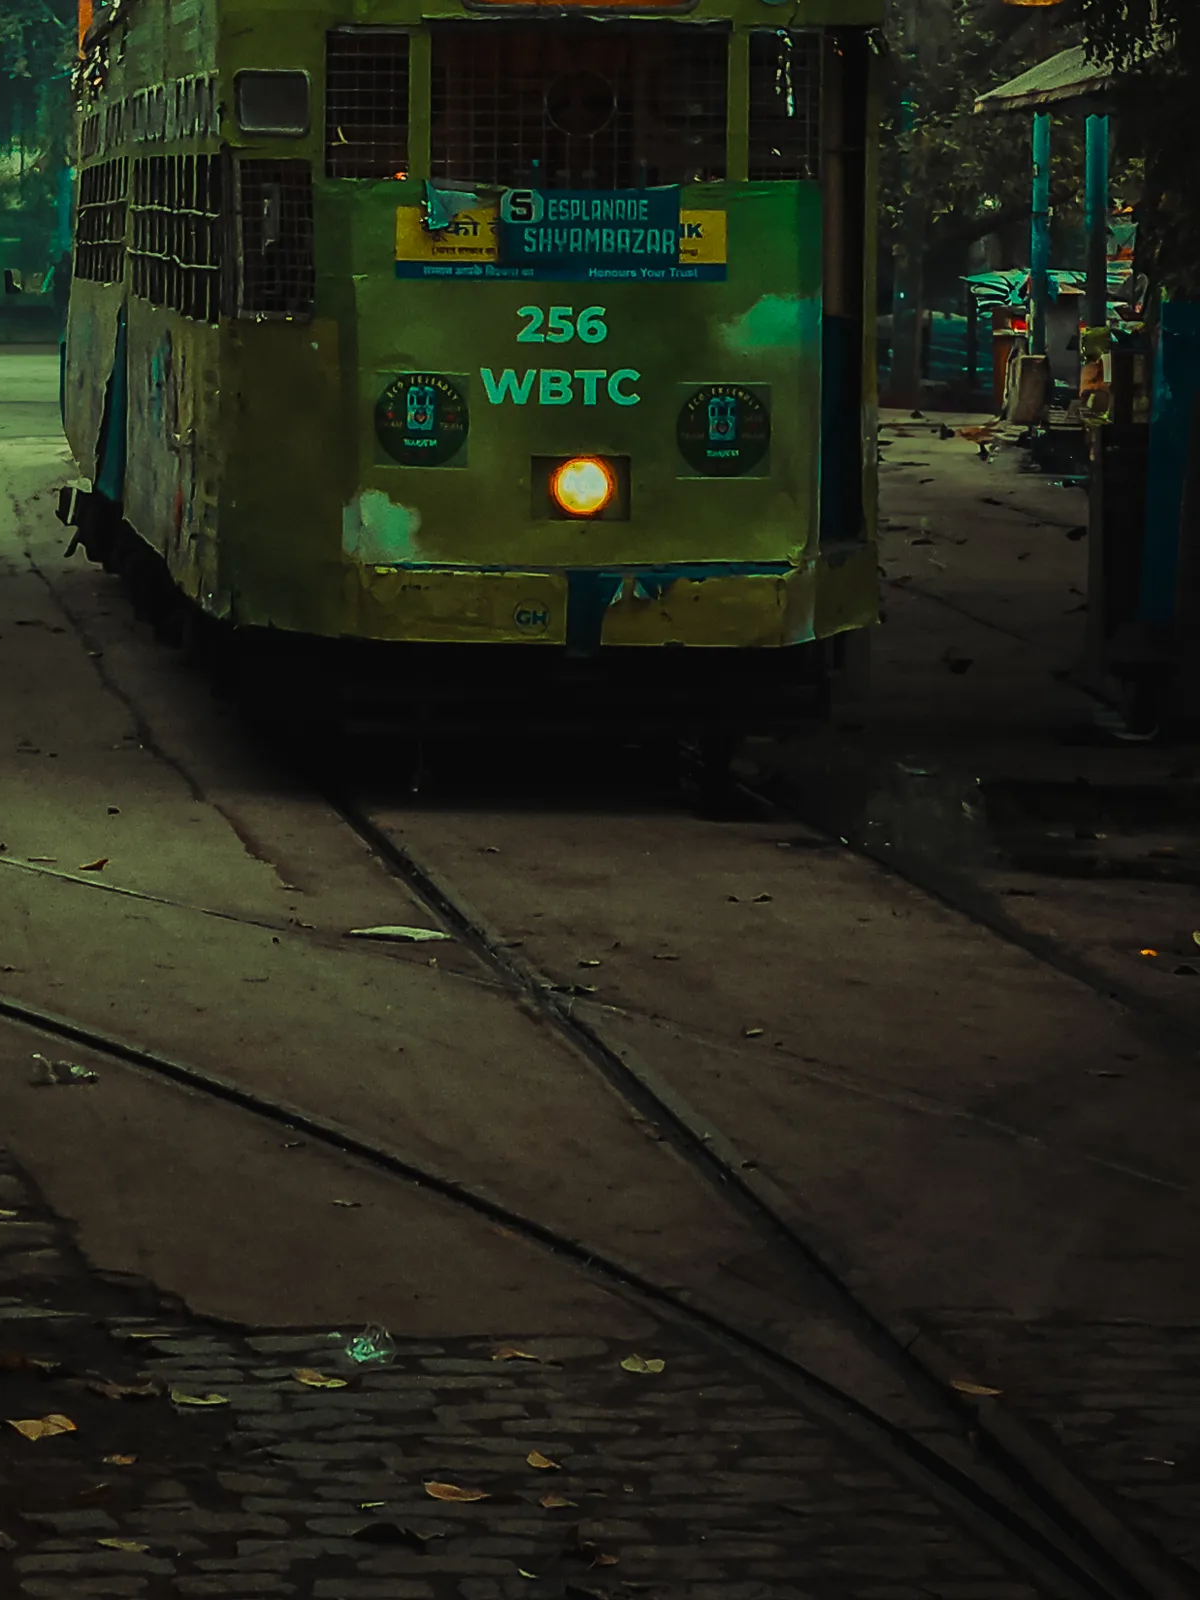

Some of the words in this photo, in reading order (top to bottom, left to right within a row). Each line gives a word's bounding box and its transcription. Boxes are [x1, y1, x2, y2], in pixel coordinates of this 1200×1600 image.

[549, 198, 649, 222] ESPLANADE
[523, 227, 676, 254] SHYAMBAZAR
[588, 267, 637, 278] Honours
[640, 267, 666, 278] Your
[669, 266, 699, 279] Trust
[516, 305, 608, 344] 256
[480, 367, 642, 407] WBTC
[516, 609, 547, 625] GH
